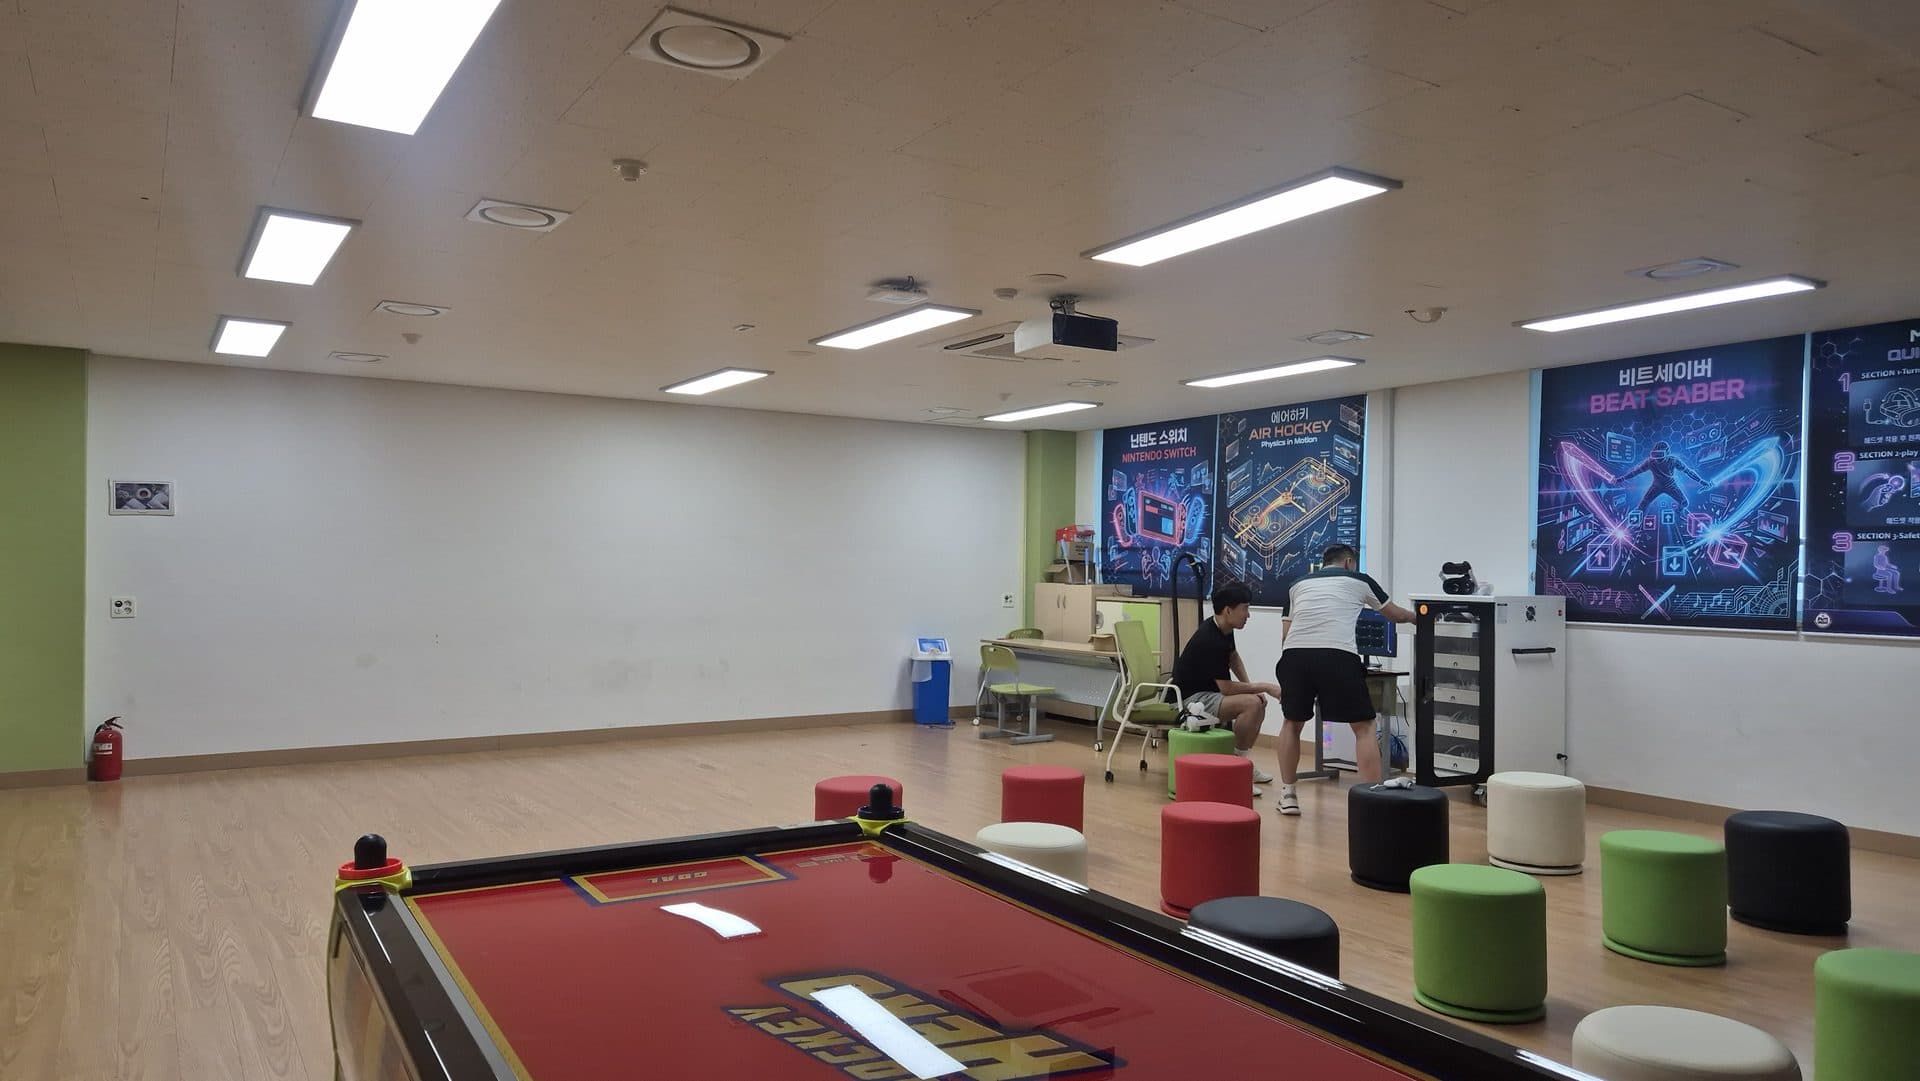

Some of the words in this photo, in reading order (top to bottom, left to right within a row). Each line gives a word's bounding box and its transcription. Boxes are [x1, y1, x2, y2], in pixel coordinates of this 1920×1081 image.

[1619, 358, 1712, 387] 비트세이버
[1838, 372, 1850, 392] 1
[1861, 370, 1895, 379] SECTION
[1590, 389, 1649, 414] BEAT
[1656, 378, 1745, 408] SABER
[1271, 407, 1308, 423] 에어하키
[1130, 432, 1157, 448] 닌텐도
[1159, 427, 1188, 445] 스위치
[1249, 427, 1272, 441] AIR
[1274, 419, 1332, 437] HOCKEY
[1261, 439, 1286, 449] Physics
[1287, 438, 1293, 446] in
[1294, 436, 1318, 445] Motion
[1122, 450, 1162, 463] NINTENDO
[1164, 446, 1197, 460] SWITCH
[1834, 451, 1855, 472] 2
[1859, 450, 1893, 459] SECTION
[1894, 449, 1918, 458] 2-play
[1831, 532, 1852, 552] 3
[1857, 532, 1891, 540] SECTION
[727, 1005, 935, 1081] OCKEY
